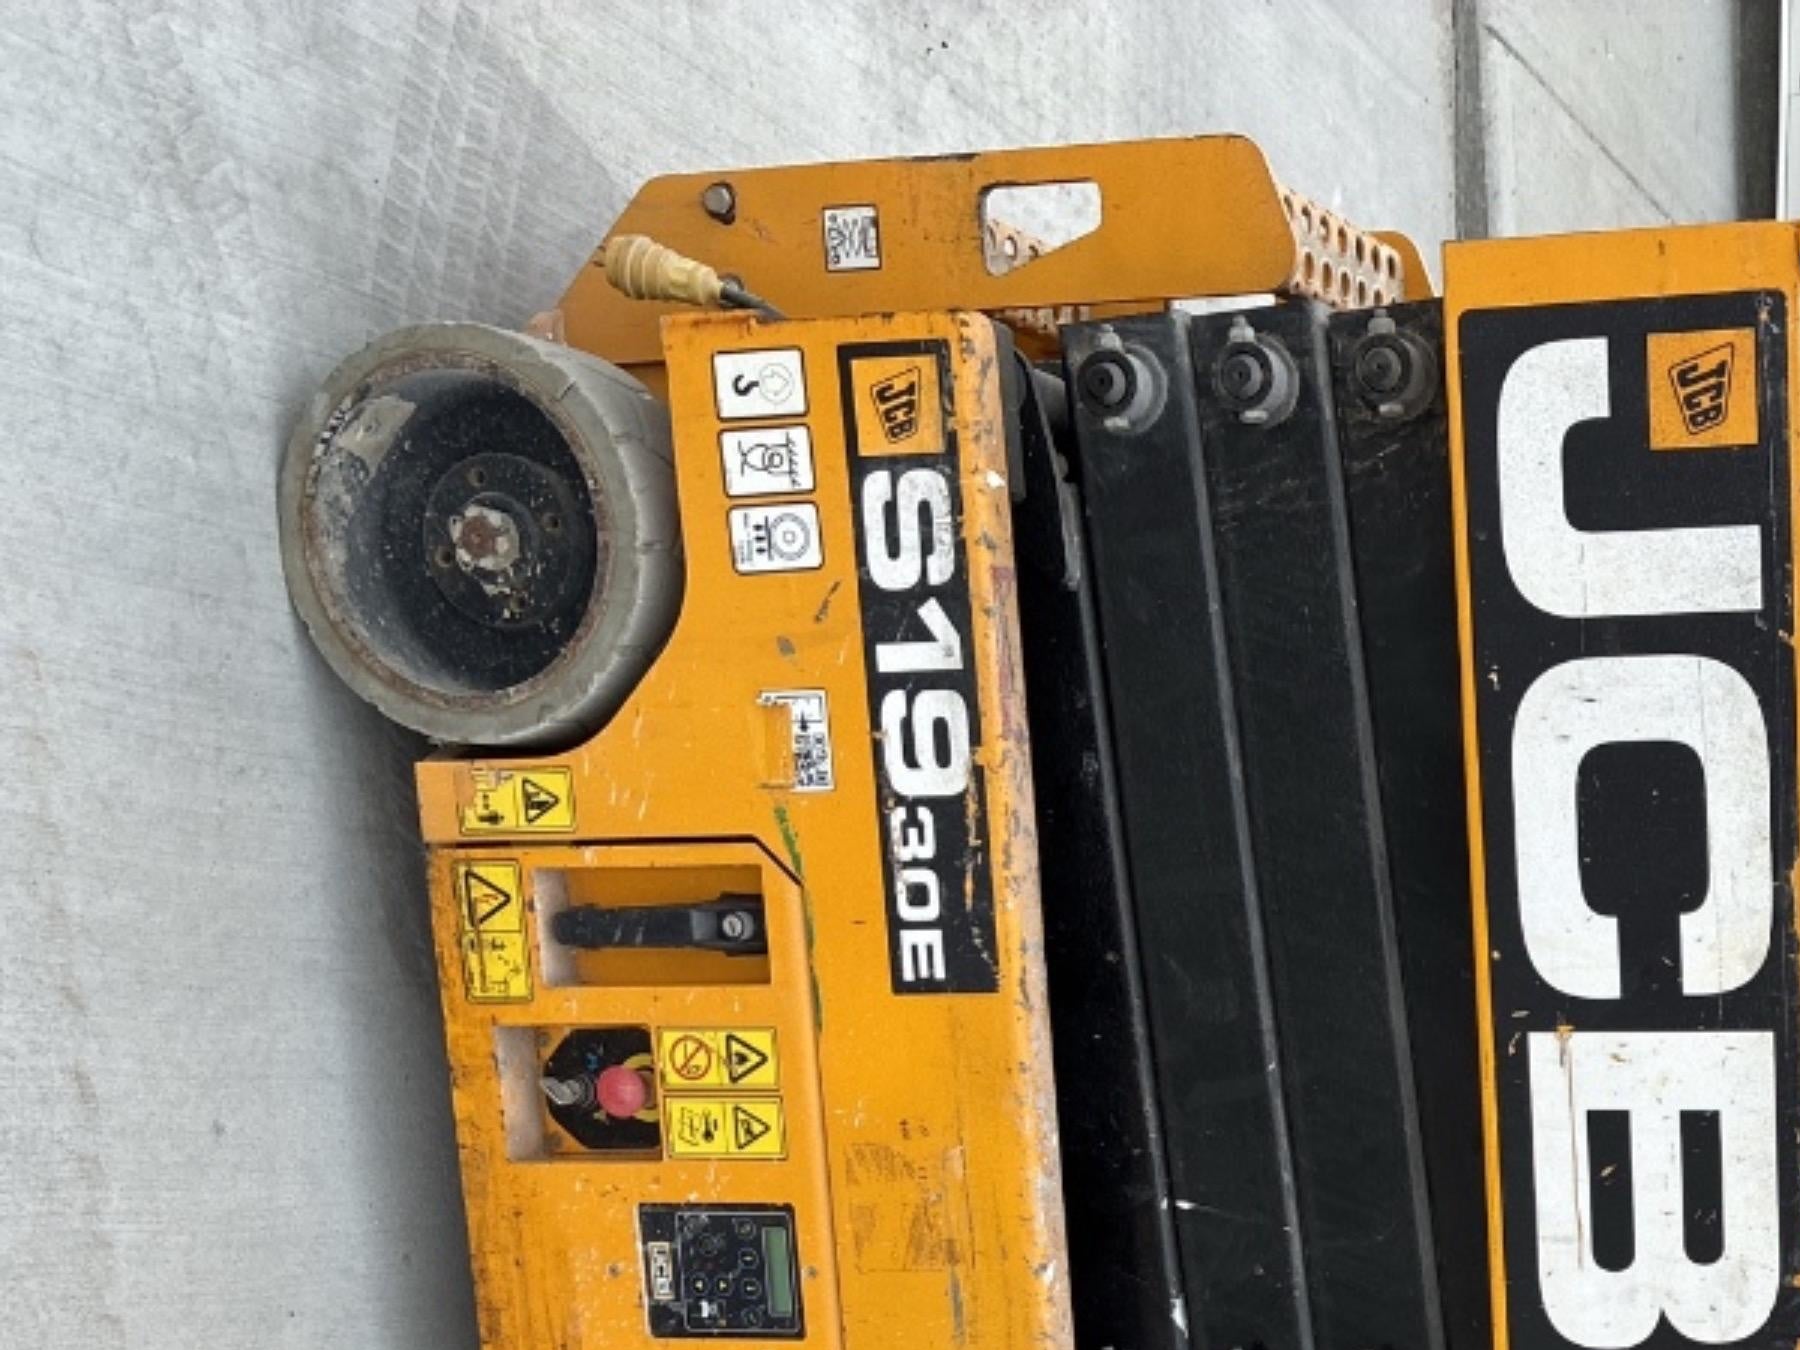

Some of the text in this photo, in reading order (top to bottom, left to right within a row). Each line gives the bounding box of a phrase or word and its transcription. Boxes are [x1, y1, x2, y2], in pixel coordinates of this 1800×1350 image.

[874, 380, 918, 441] JCB
[1674, 356, 1732, 432] JCB
[861, 468, 972, 984] S1930E
[1496, 334, 1781, 1350] JCB
